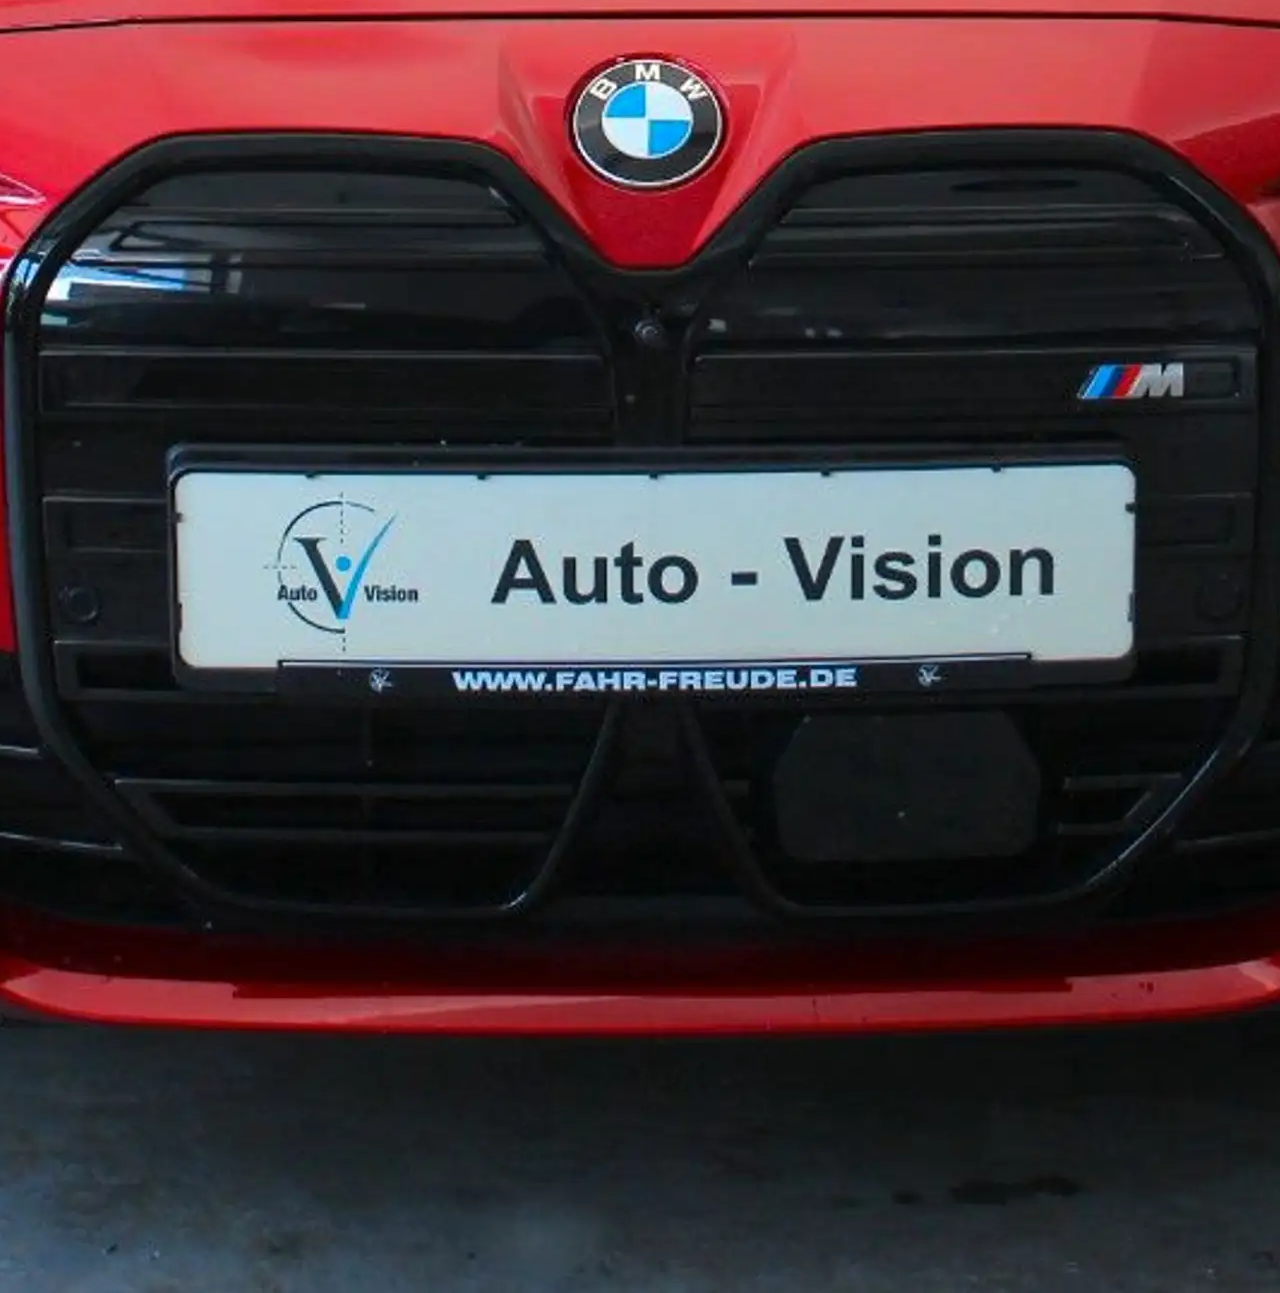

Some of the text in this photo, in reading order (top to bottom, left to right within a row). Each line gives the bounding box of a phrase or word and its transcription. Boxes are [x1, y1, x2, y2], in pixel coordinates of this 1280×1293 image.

[590, 63, 707, 101] BMW
[1130, 362, 1184, 398] M
[490, 534, 1055, 605] Auto - Vision
[277, 585, 419, 603] Auto Vision
[453, 667, 857, 693] WWW.FAHR-FREUDE.DE
